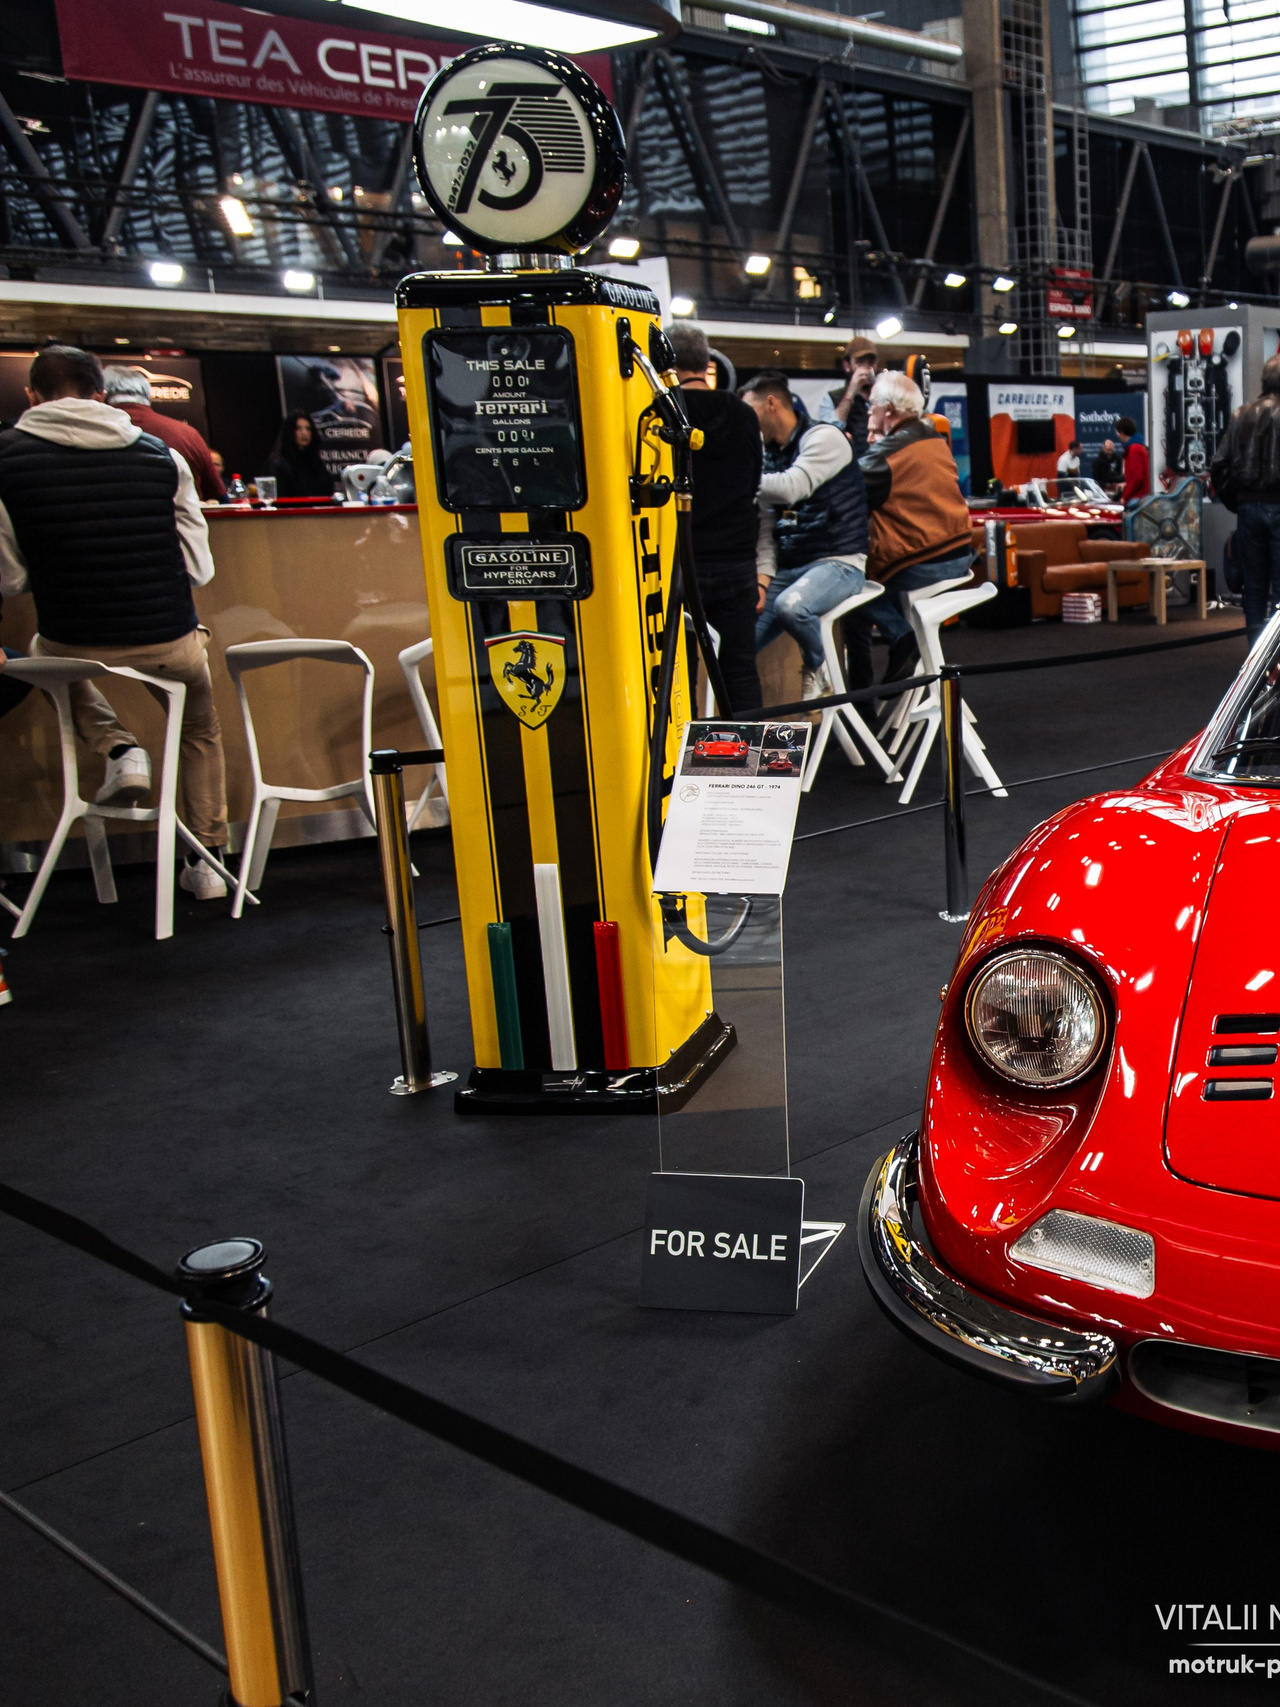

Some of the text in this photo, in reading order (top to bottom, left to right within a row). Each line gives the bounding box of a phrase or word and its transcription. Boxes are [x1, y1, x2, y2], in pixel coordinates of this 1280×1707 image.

[163, 12, 458, 91] TEA CER
[169, 61, 251, 89] L'assureur
[256, 74, 285, 93] des
[443, 82, 566, 213] 75
[445, 139, 478, 213] 1947-2022
[601, 280, 659, 310] GASOLINE
[466, 359, 546, 372] THIS SALE
[148, 386, 190, 400] REDE
[474, 400, 548, 415] Ferrari
[475, 552, 562, 563] GASOLINE
[483, 570, 557, 578] HYPERCARS
[650, 1229, 788, 1261] FOR SALE
